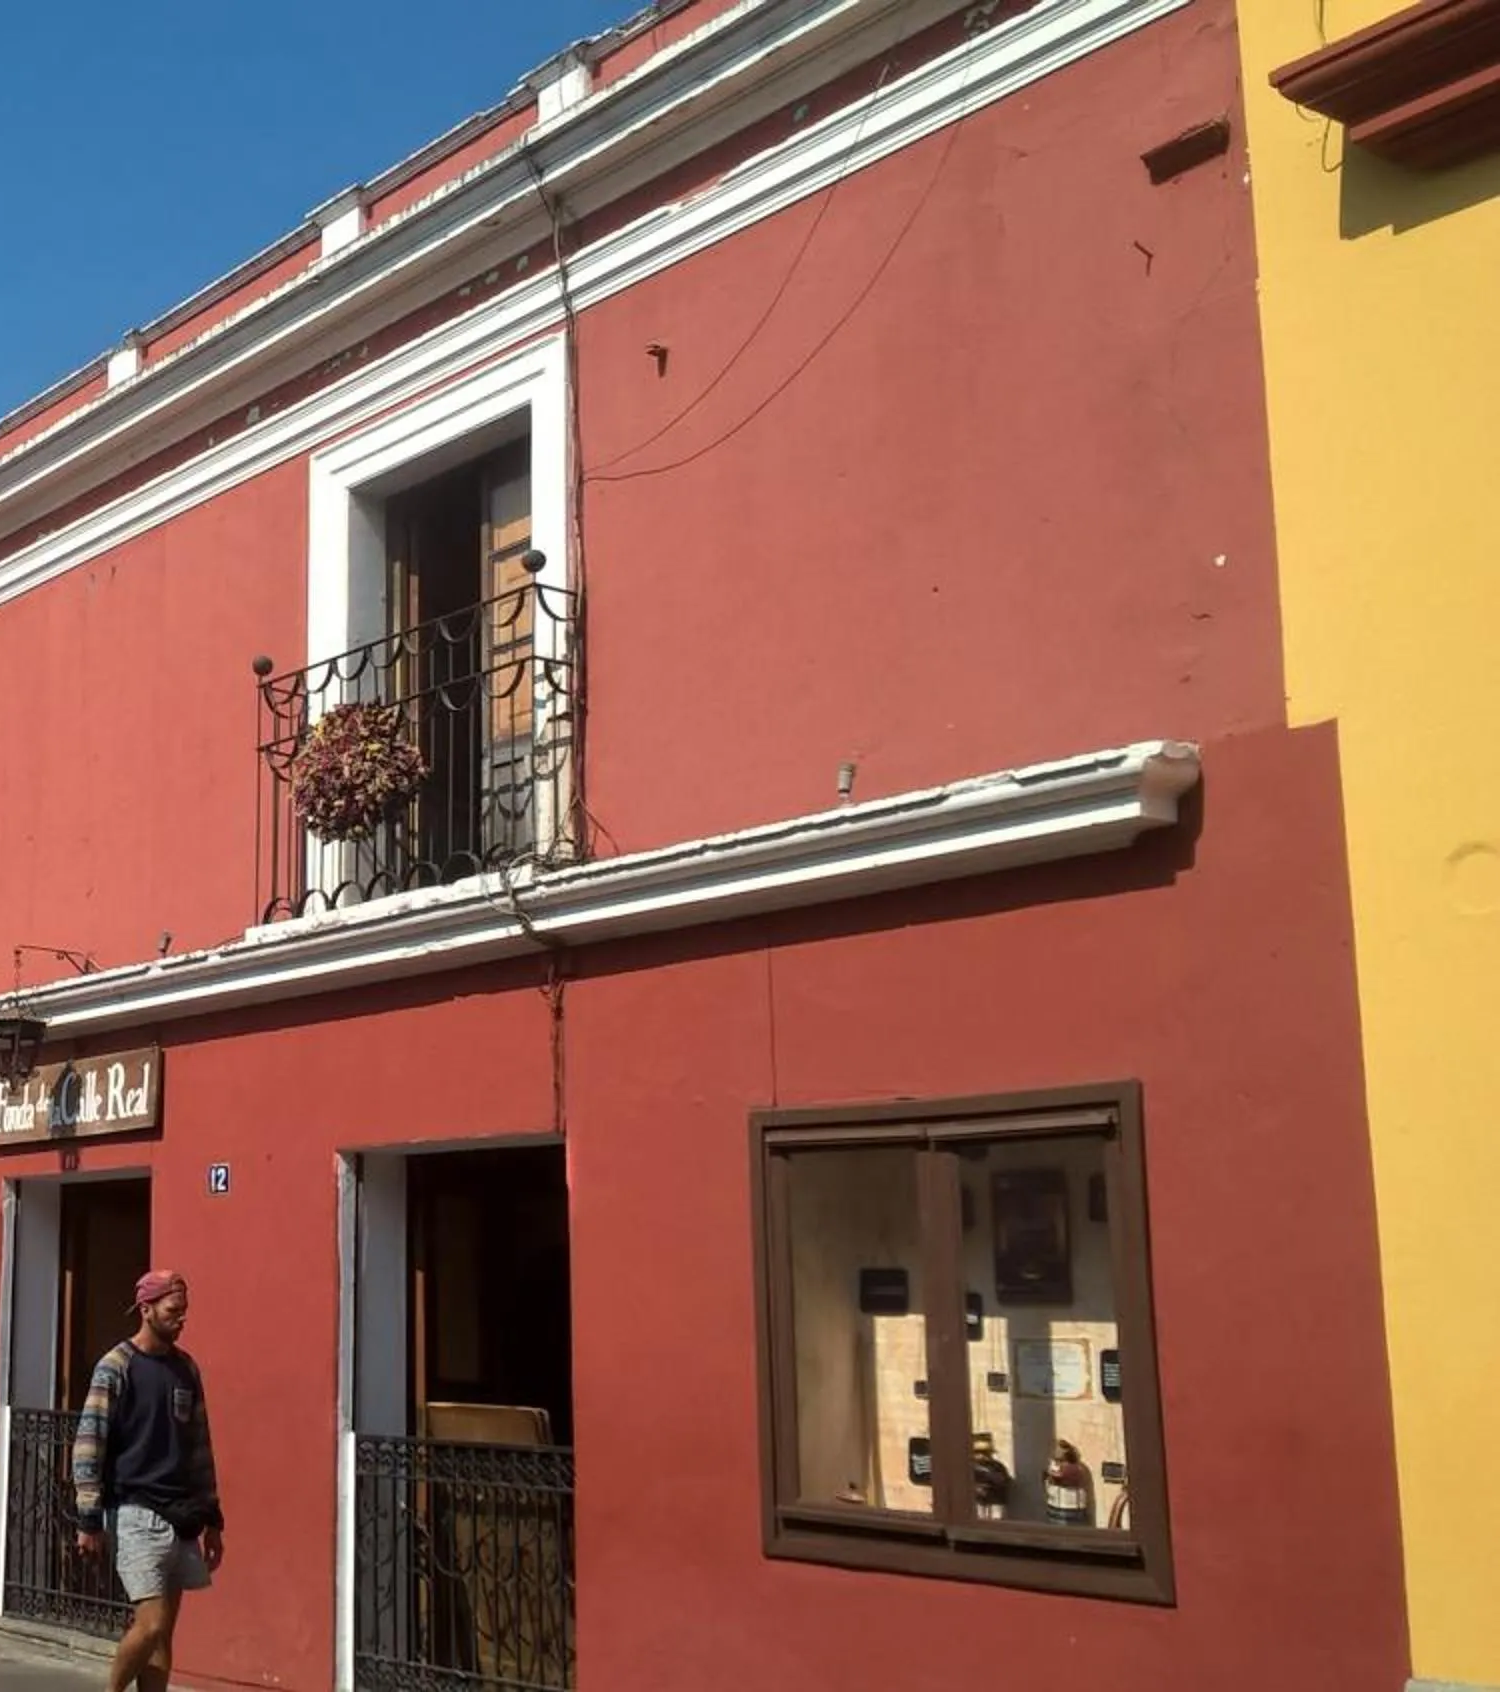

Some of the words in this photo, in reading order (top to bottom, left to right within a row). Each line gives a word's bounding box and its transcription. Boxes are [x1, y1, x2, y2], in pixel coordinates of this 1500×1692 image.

[61, 1071, 102, 1125] Calle
[105, 1062, 150, 1120] Real
[211, 1167, 227, 1191] 12
